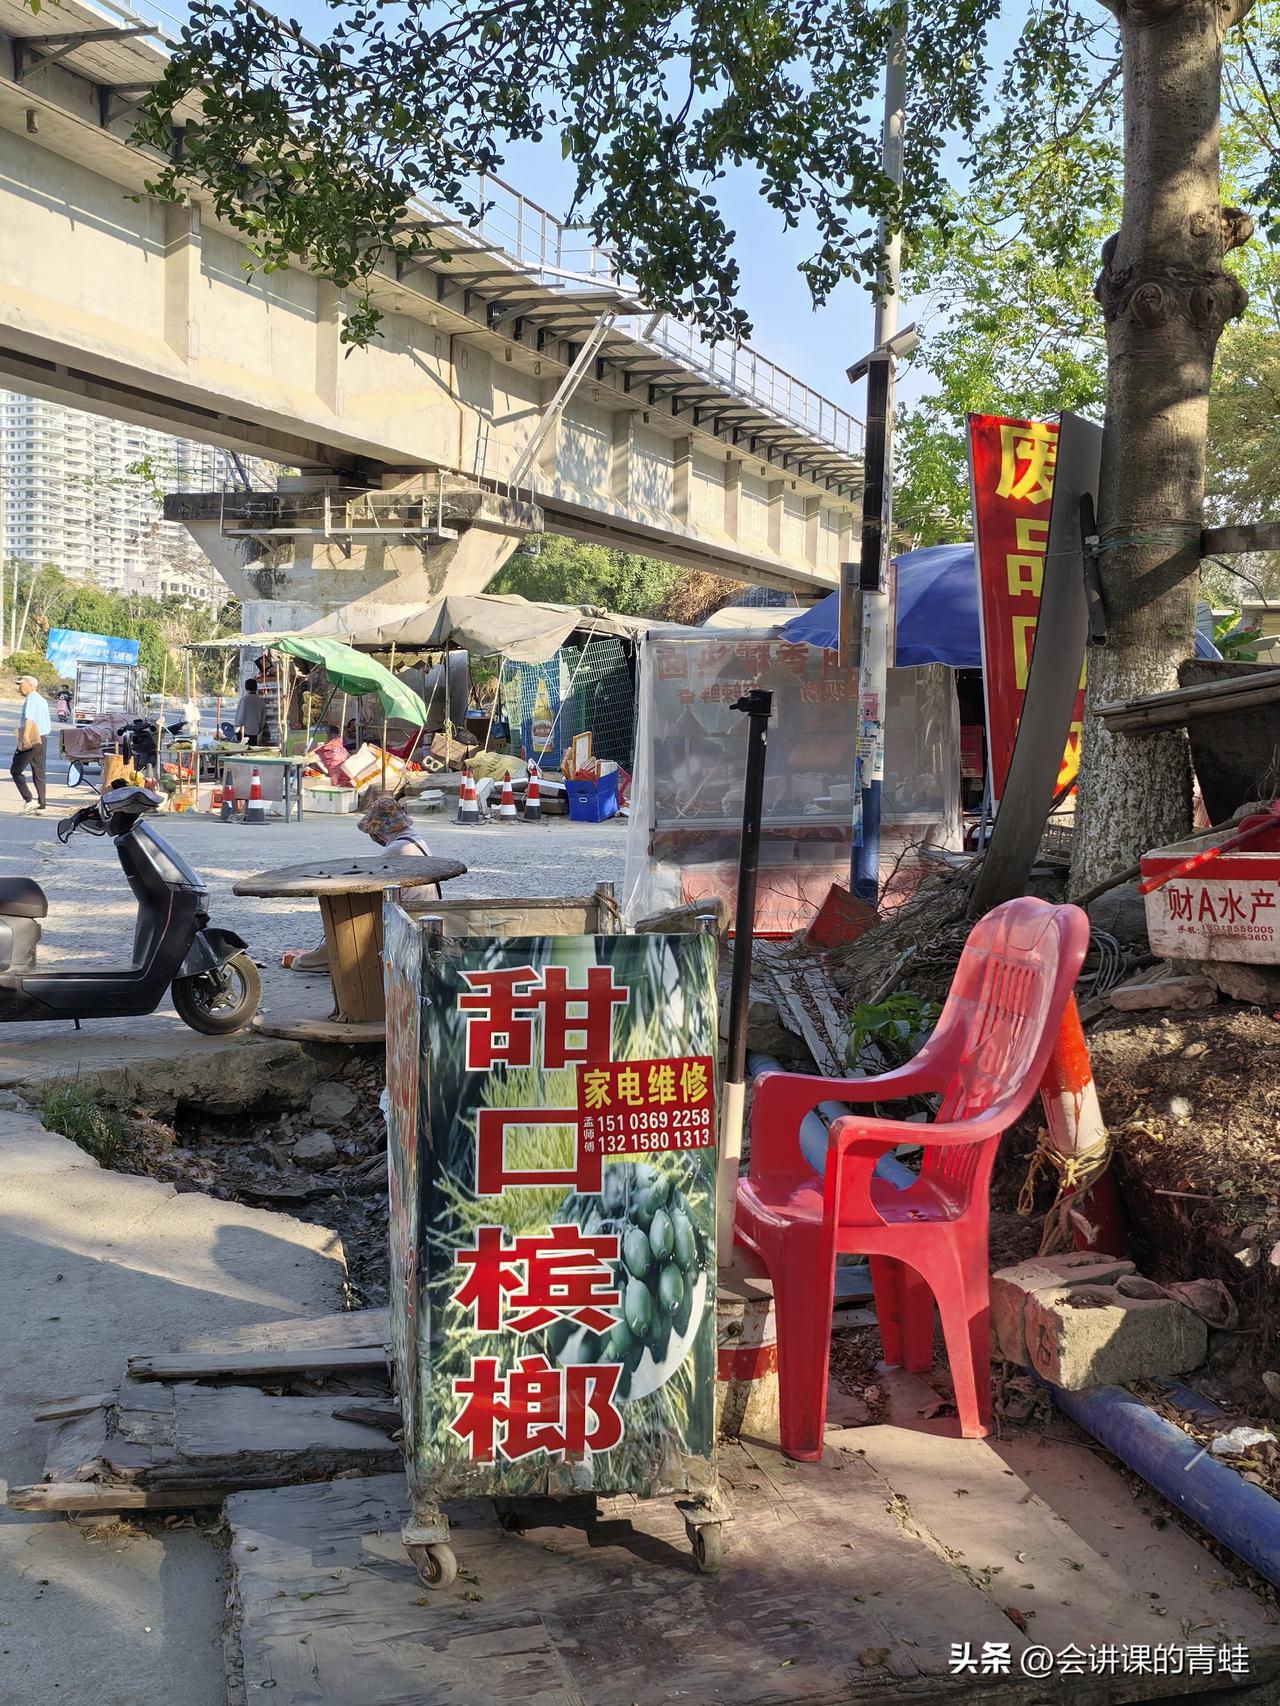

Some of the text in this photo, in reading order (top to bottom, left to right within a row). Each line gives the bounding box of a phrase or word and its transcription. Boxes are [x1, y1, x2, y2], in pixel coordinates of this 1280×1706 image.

[1168, 886, 1277, 924] 财A水产
[583, 1062, 708, 1109] 家电维修
[583, 1116, 595, 1153] 孟师傅
[597, 1108, 710, 1133] 151 0369 2258
[598, 1128, 710, 1153] 132 1580 1313
[451, 965, 630, 1465] 甜口槟榔
